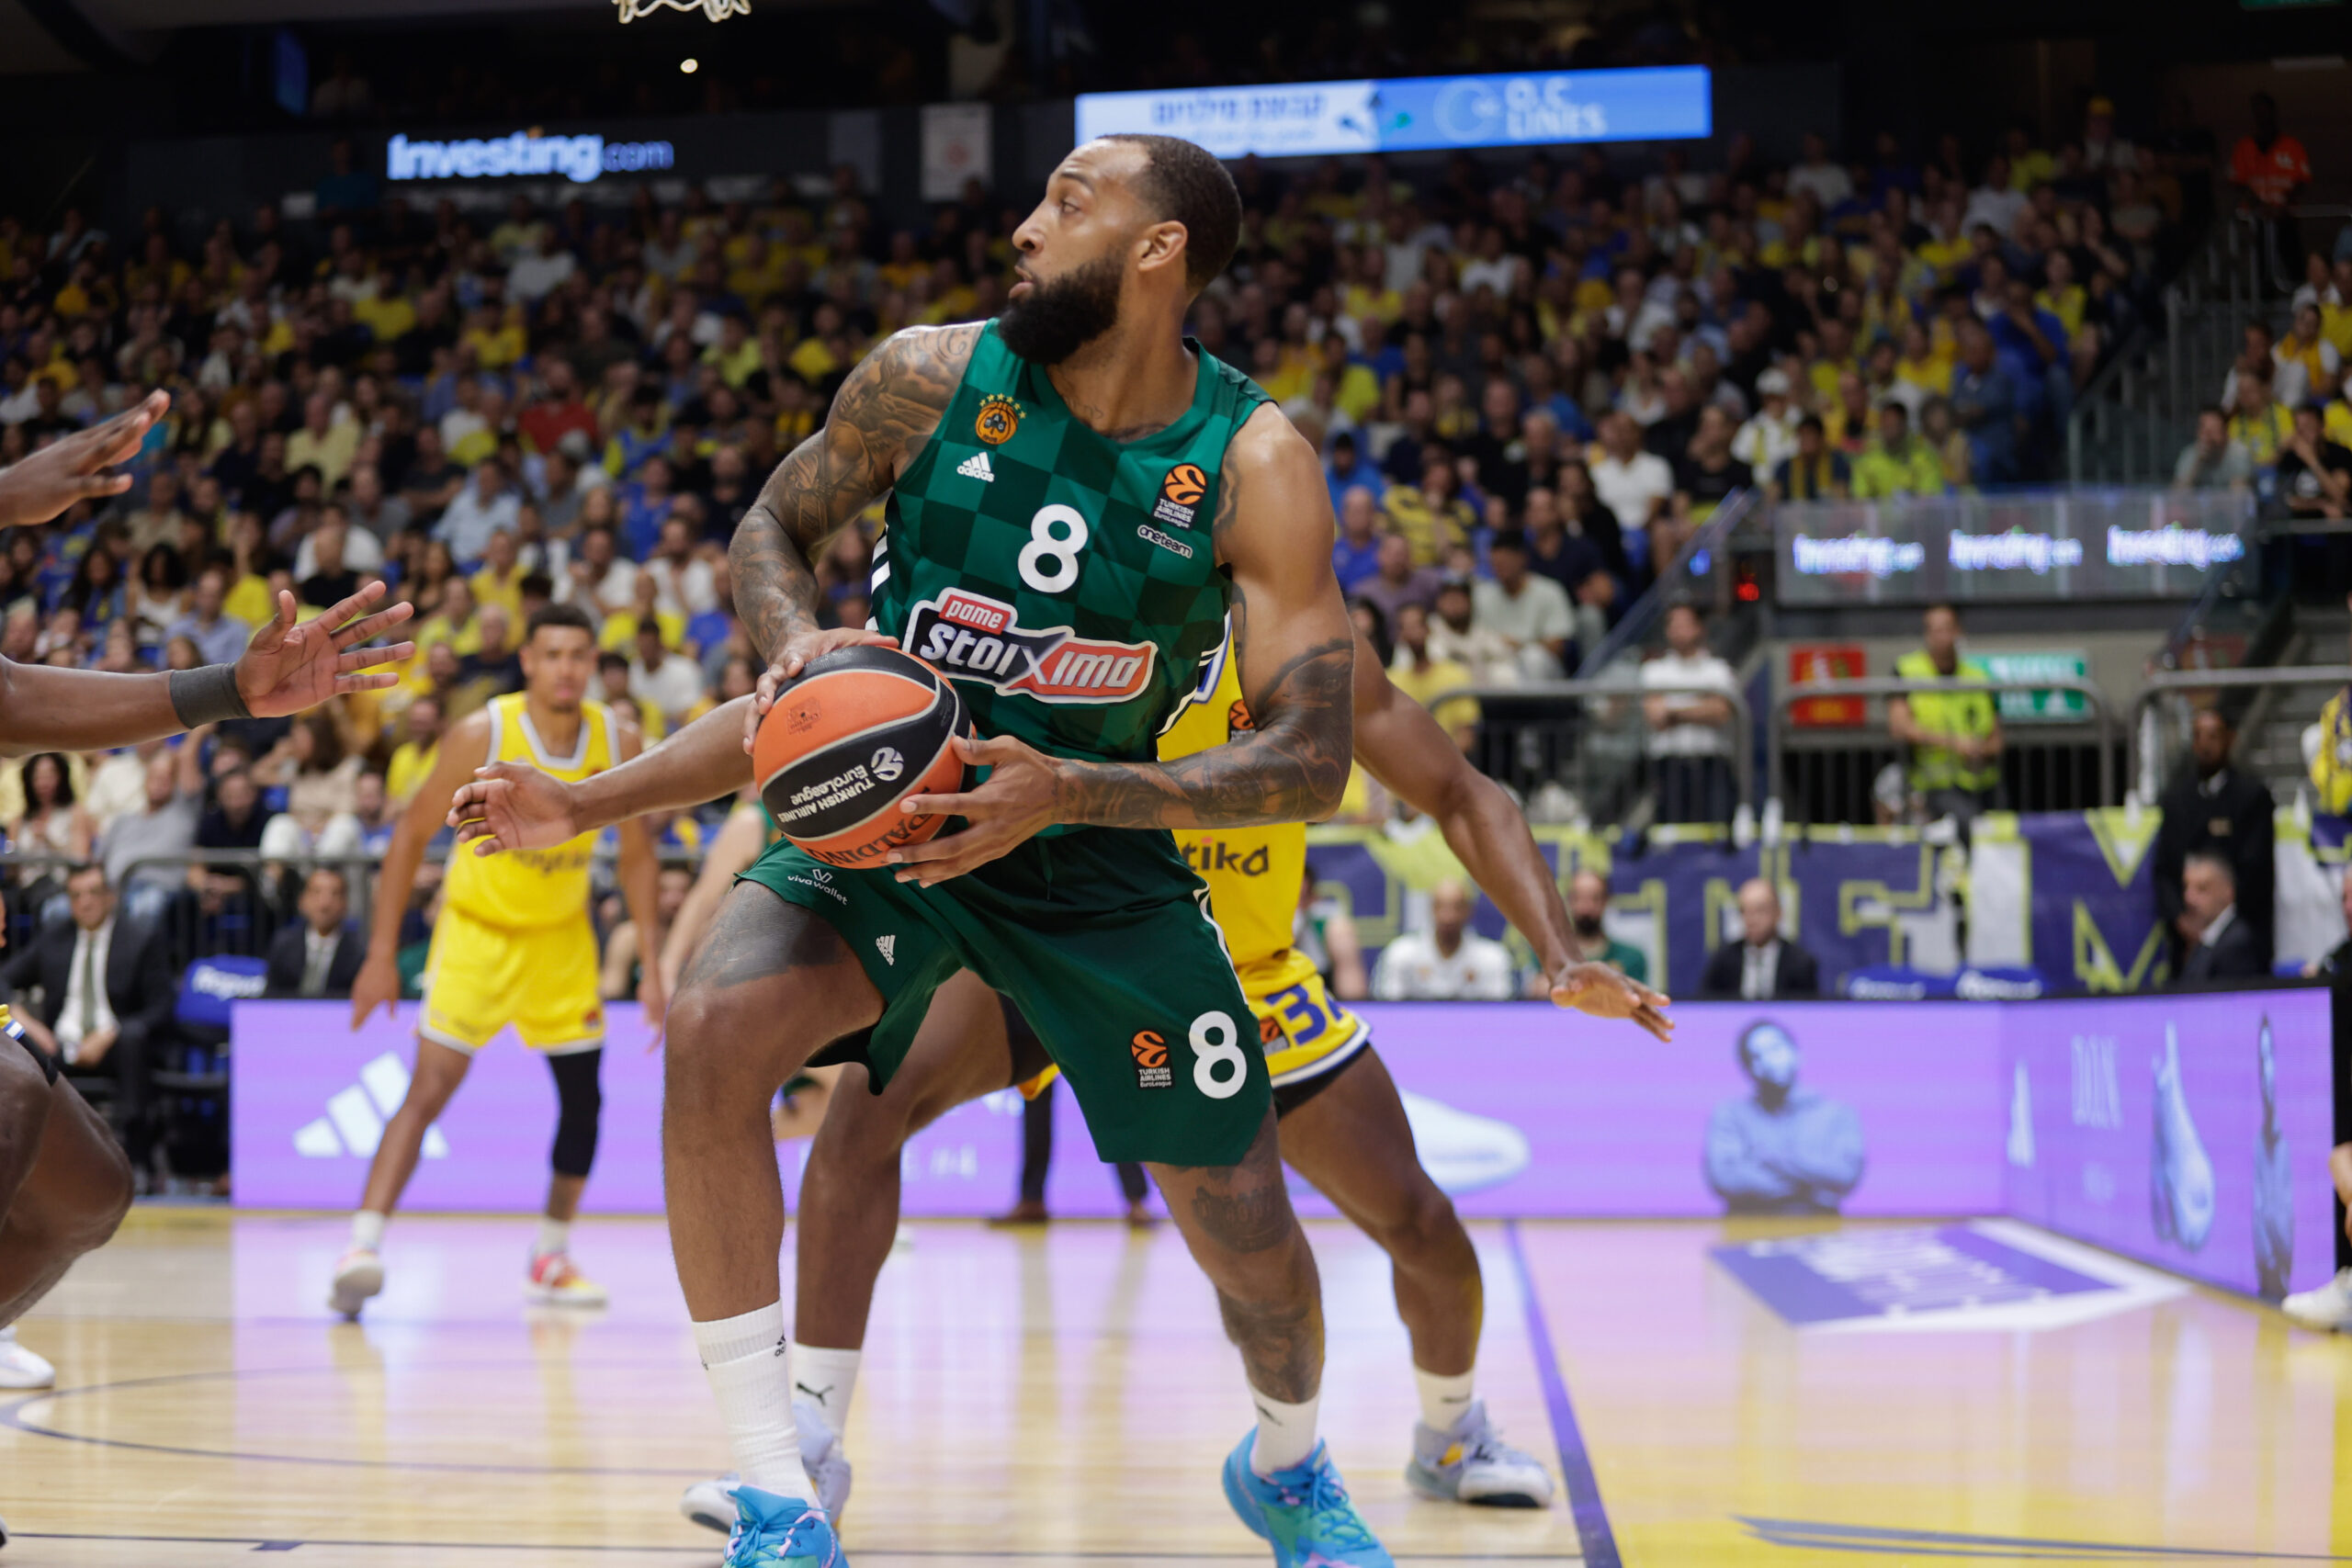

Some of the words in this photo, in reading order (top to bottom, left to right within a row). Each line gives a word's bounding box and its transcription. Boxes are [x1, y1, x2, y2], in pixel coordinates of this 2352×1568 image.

[956, 465, 995, 482] adidas
[1156, 505, 1192, 523] AIRLINES
[1159, 498, 1194, 516] TURKISH
[1018, 504, 1088, 593] 8
[1138, 525, 1193, 558] oneteam
[945, 600, 1004, 629] pame
[791, 765, 868, 806] EuroLeague
[819, 779, 875, 810] TURKISH
[777, 804, 817, 823] AIRLINES
[807, 786, 934, 864] PALDING
[1182, 837, 1269, 876] tika
[1189, 1010, 1248, 1099] 8
[1138, 1067, 1170, 1076] TURKISH
[1139, 1074, 1171, 1082] AIRLINES
[1140, 1080, 1172, 1089] EuroLeague
